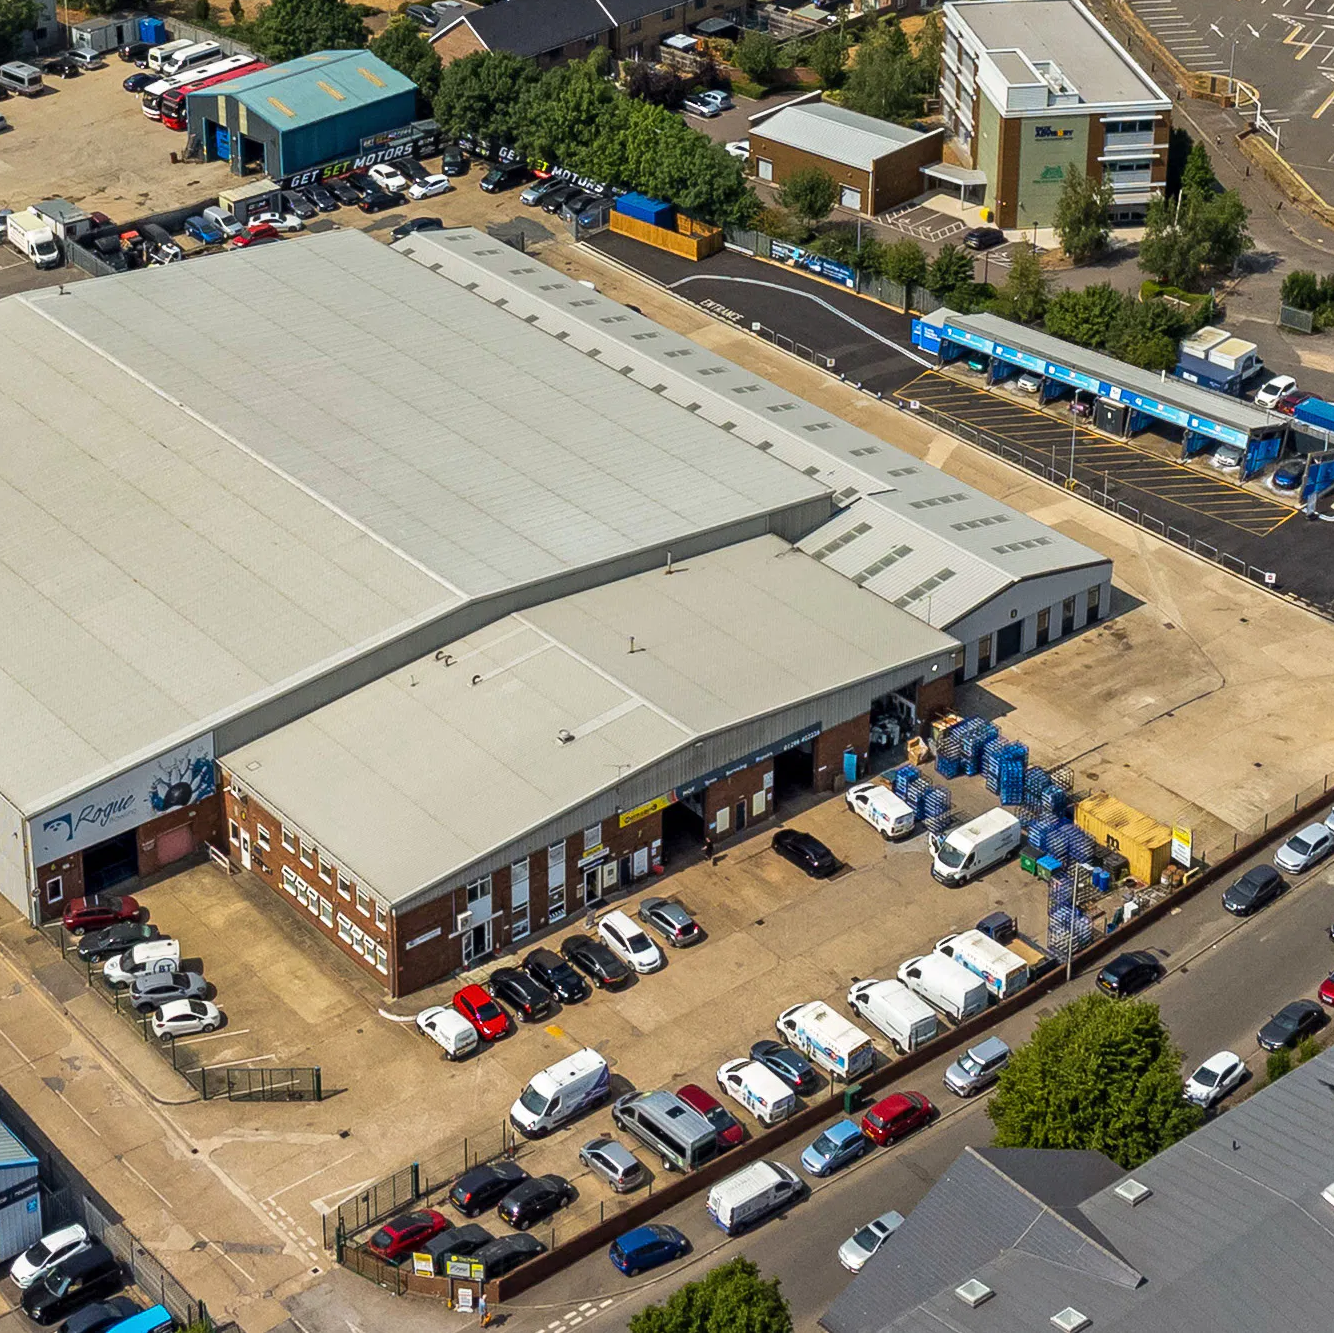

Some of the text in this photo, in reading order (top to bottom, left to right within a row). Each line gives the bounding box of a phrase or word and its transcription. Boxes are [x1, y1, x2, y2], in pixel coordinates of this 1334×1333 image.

[290, 143, 414, 188] GET SET MOTORS
[499, 146, 520, 160] GE
[551, 166, 606, 193] MOTORS
[74, 794, 136, 832] Rogue
[158, 963, 172, 974] BT
